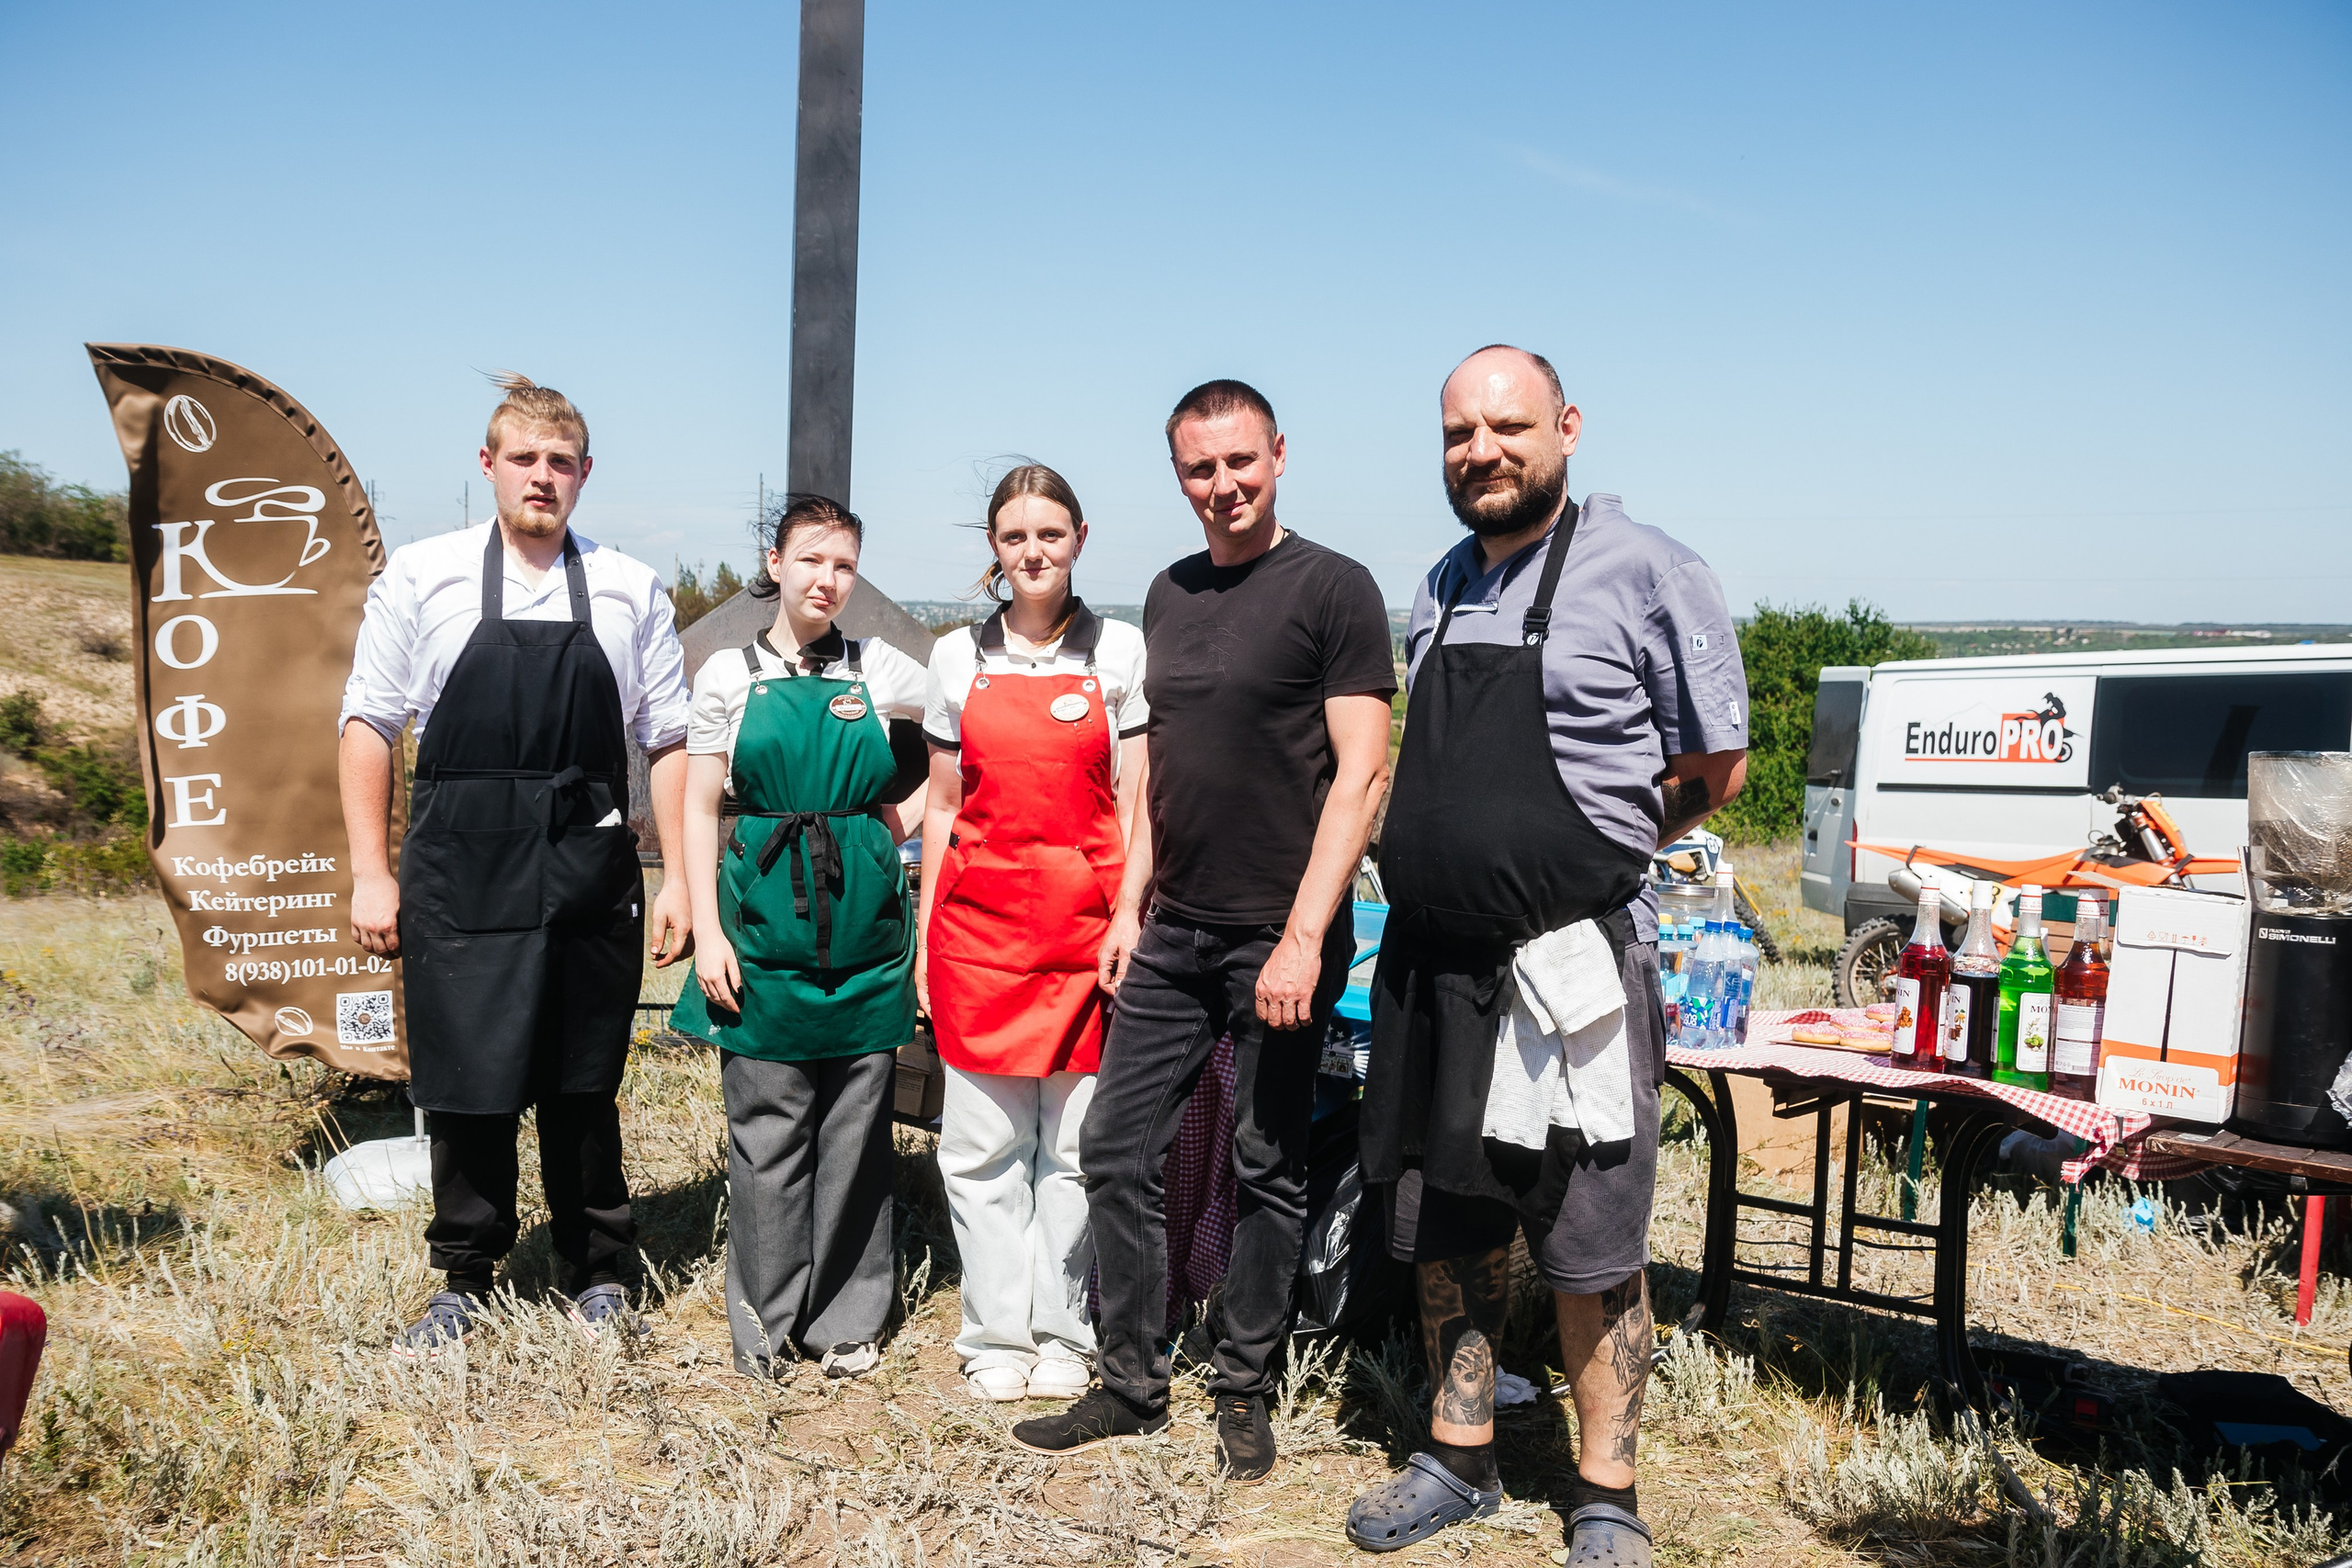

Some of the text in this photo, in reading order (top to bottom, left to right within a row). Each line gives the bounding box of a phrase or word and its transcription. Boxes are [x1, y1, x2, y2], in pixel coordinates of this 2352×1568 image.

[151, 519, 237, 829] КОФЕ
[1905, 718, 2064, 761] EnduroPRO
[171, 852, 336, 884] Кофебрейк
[187, 889, 337, 918] Кейтеринг
[202, 925, 337, 954] Фуршеты
[2267, 933, 2336, 944] SIMONELLI
[2119, 1077, 2197, 1100] MONIN
[2129, 1066, 2145, 1077] Le
[2147, 1068, 2175, 1084] Sirop
